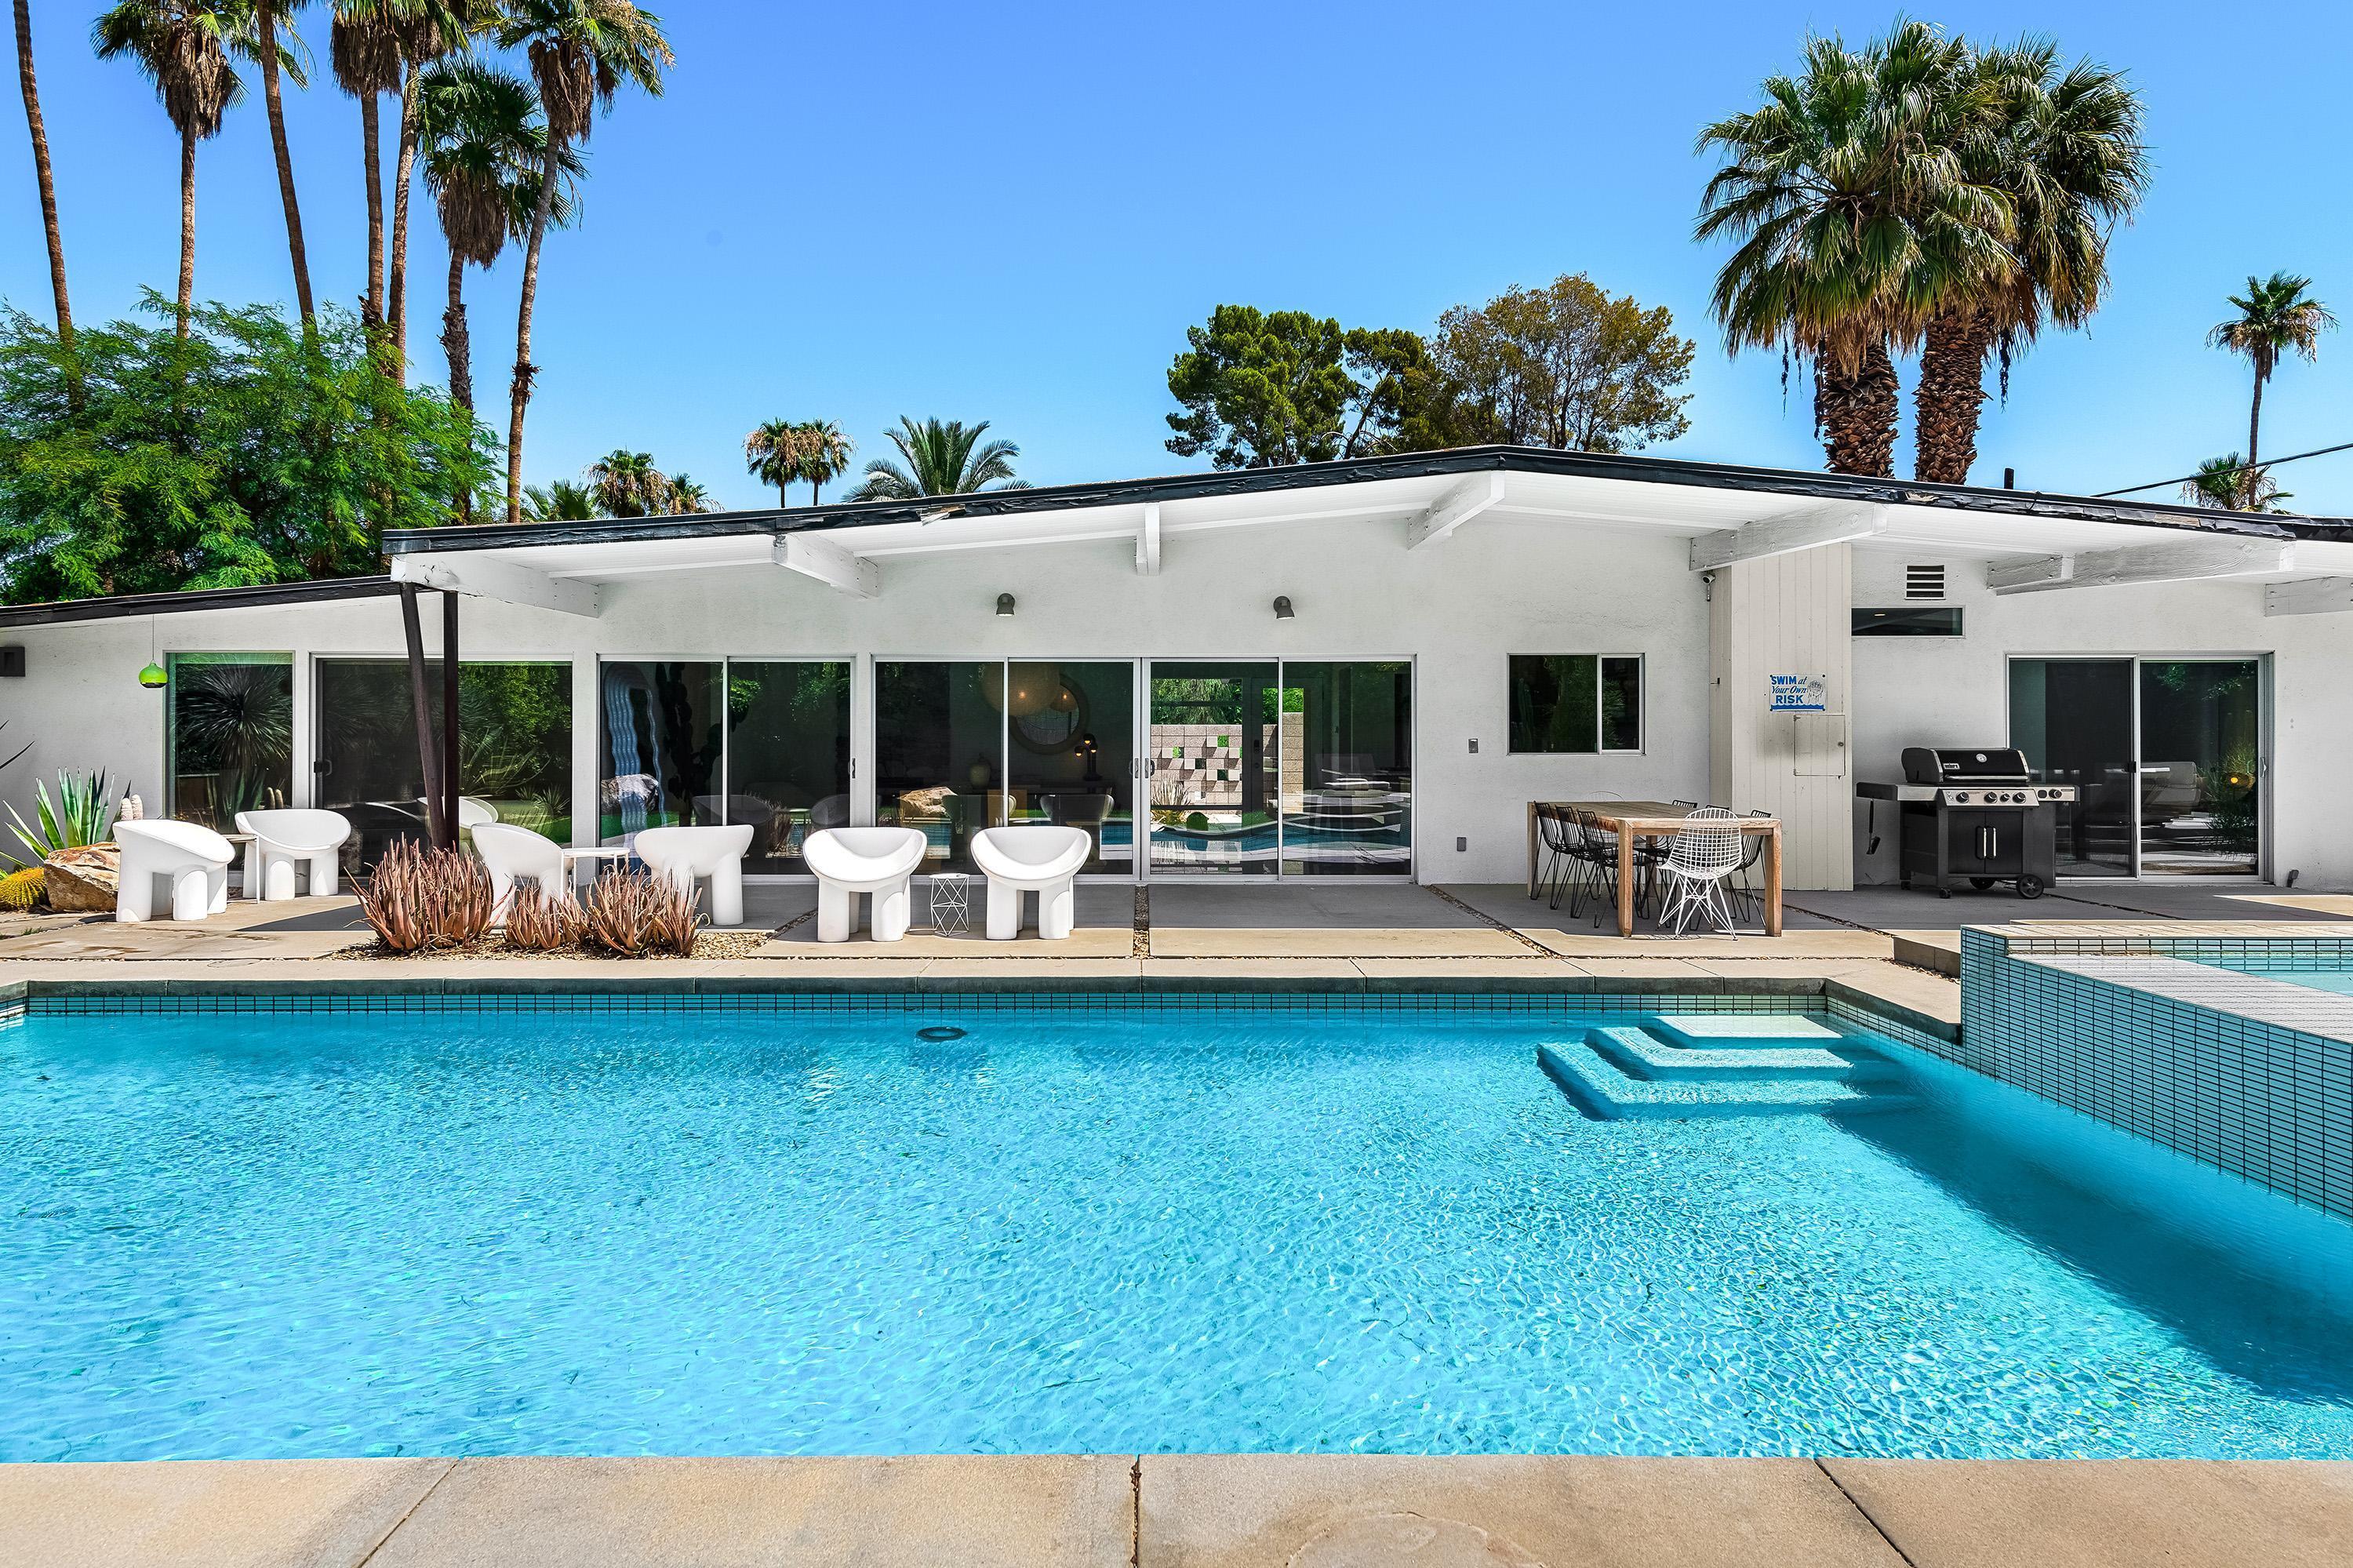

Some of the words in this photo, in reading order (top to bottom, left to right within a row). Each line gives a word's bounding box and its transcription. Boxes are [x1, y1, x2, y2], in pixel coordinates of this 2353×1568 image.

[1771, 676, 1797, 685] SWIM
[1798, 676, 1807, 685] at
[1776, 695, 1803, 704] RISK
